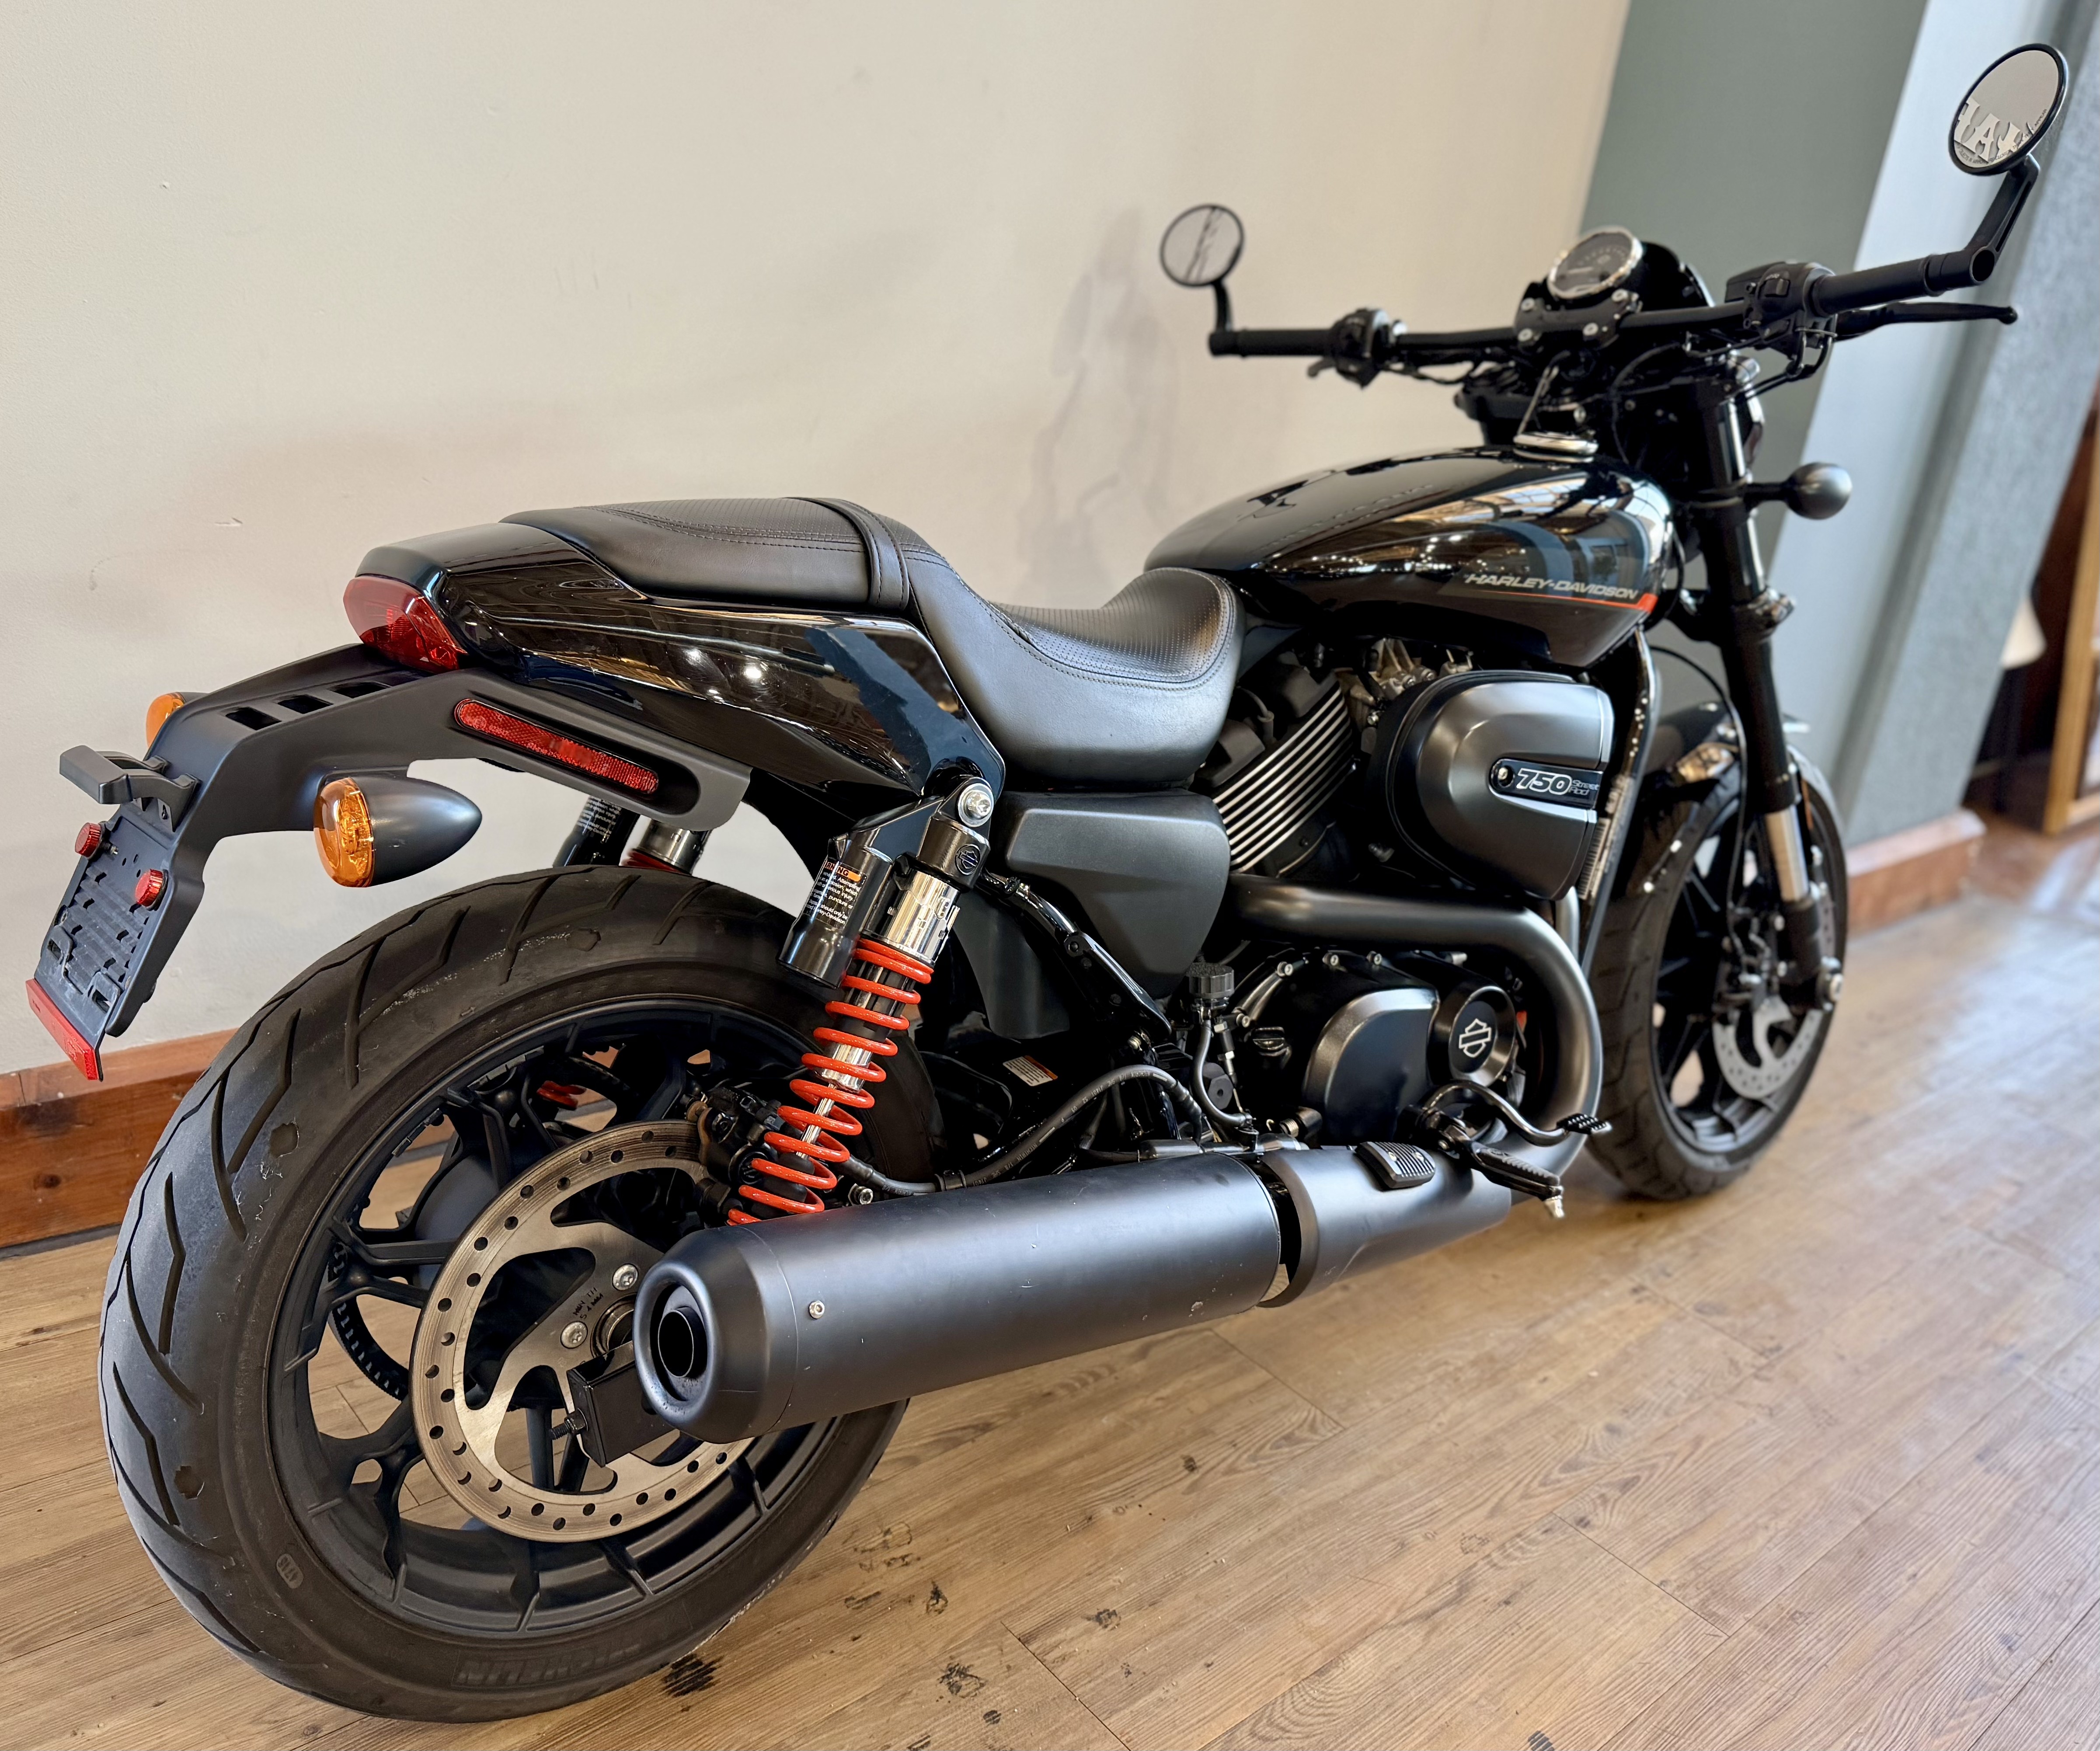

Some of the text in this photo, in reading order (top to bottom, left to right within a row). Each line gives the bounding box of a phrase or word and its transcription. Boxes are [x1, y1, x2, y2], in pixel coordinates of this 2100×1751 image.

[1516, 768, 1573, 795] 750
[1572, 780, 1600, 790] Street
[1569, 787, 1590, 796] Rod
